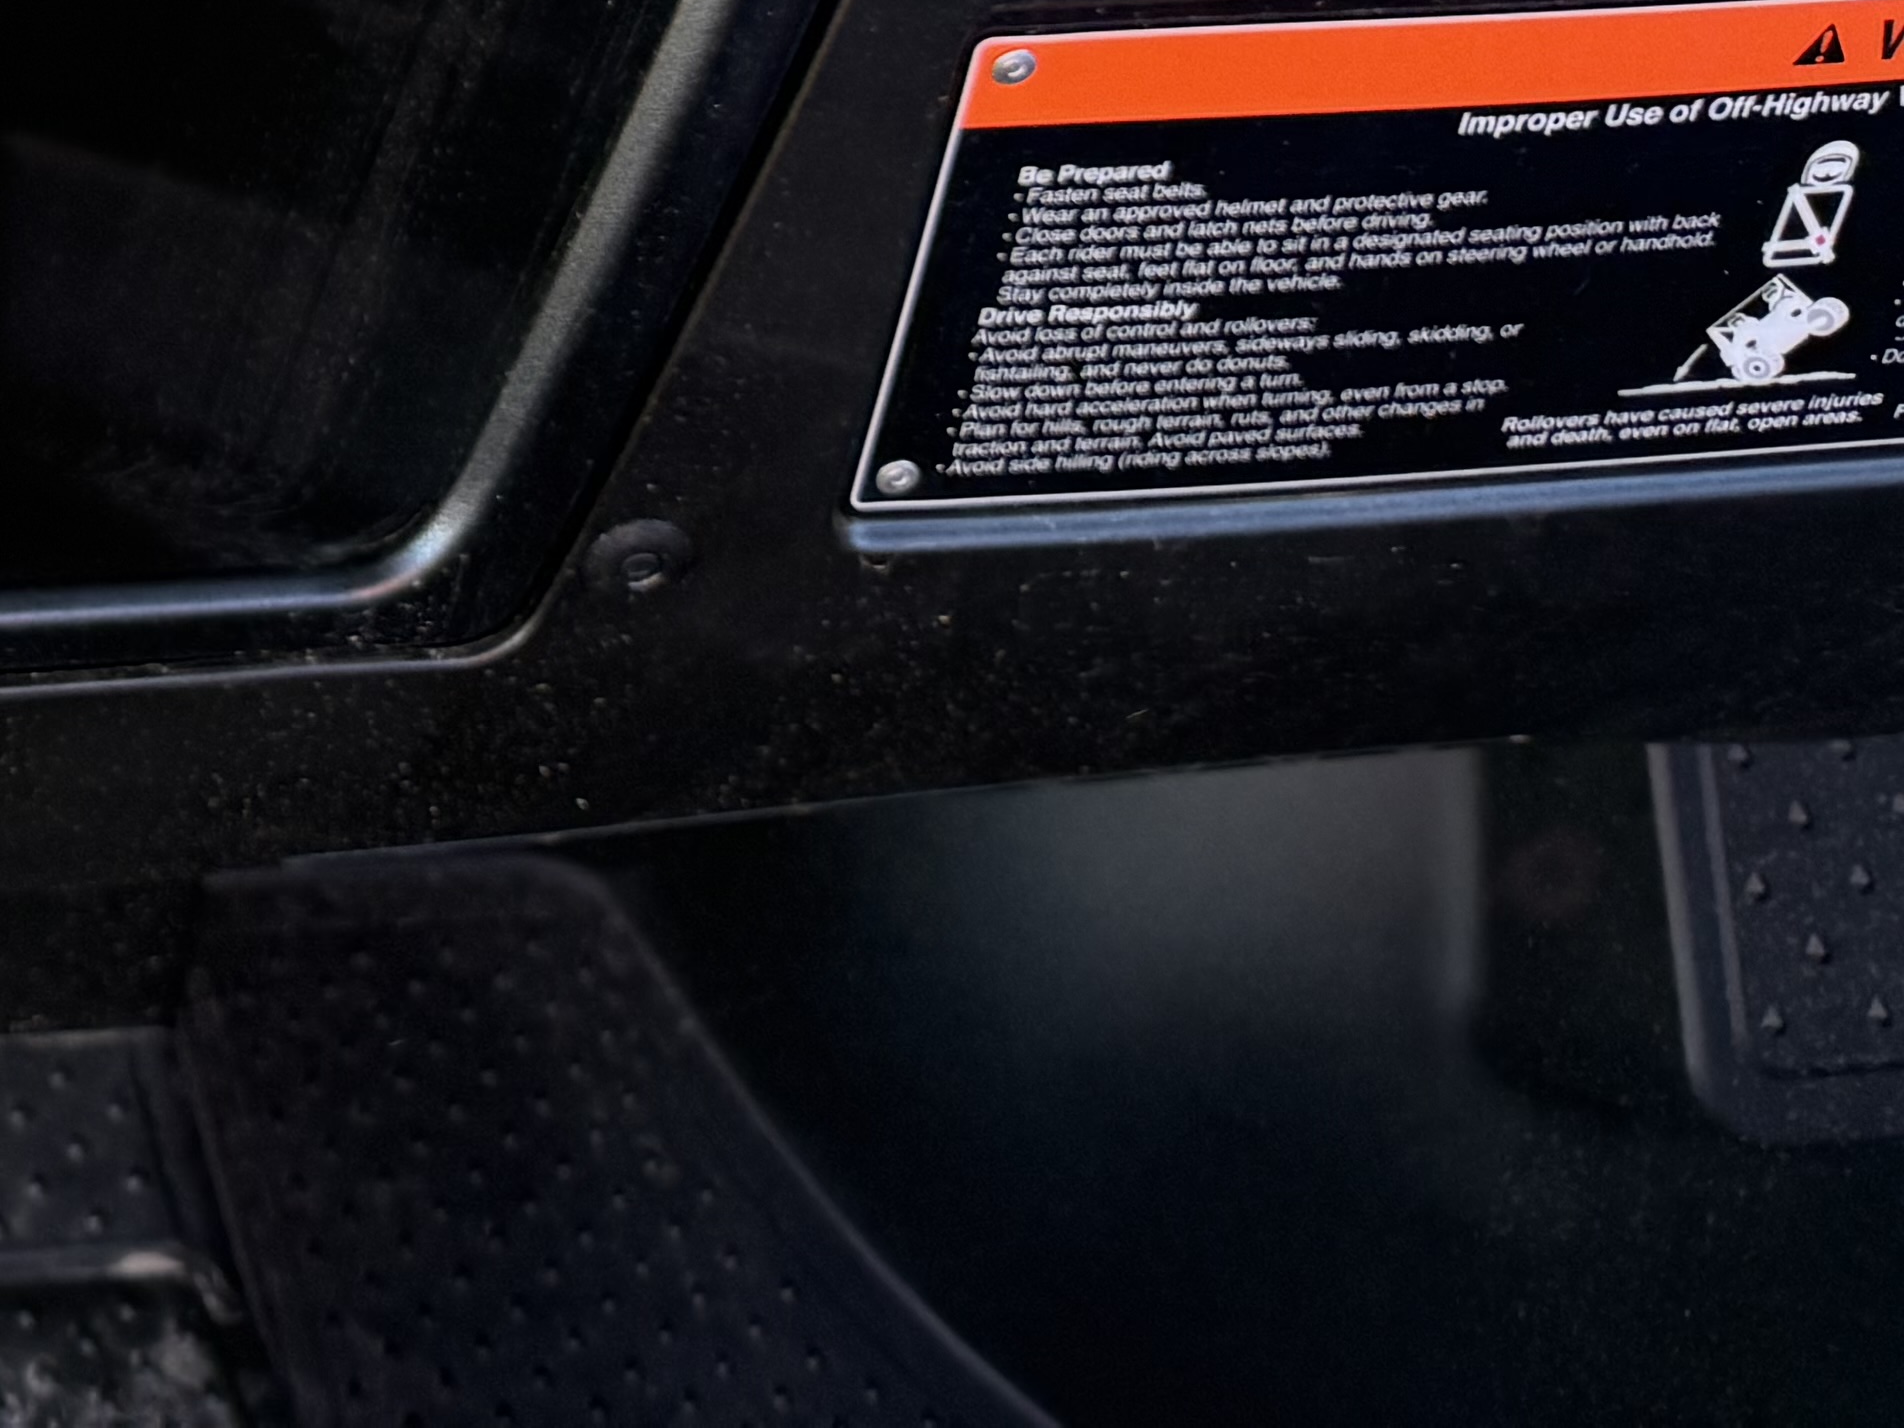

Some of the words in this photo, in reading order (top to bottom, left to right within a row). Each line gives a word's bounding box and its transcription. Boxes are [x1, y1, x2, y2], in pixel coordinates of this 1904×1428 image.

[1458, 110, 1599, 138] Improper
[1605, 103, 1661, 127] Use
[1670, 98, 1700, 122] of
[1708, 89, 1888, 121] Off-Highway
[1018, 166, 1055, 185] Be
[1057, 161, 1172, 185] Prepared
[1021, 207, 1079, 225] Wear
[1081, 208, 1109, 222] an
[1113, 201, 1209, 224] approved
[1215, 198, 1287, 217] helmet
[1290, 196, 1329, 214] and
[1333, 191, 1434, 215] protective
[1438, 188, 1488, 211] gear.
[1025, 185, 1098, 205] Fasten
[1103, 185, 1149, 202] seat
[1015, 227, 1076, 244] Close
[1079, 223, 1140, 242] doors
[1144, 221, 1183, 239] and
[1291, 214, 1357, 231] before
[1361, 211, 1434, 233] driving.
[996, 285, 1045, 306] Stay
[1048, 280, 1160, 304] completely
[1164, 277, 1226, 296] inside
[1229, 275, 1263, 293] the
[977, 307, 1044, 326] Drive
[1048, 300, 1198, 324] Responsibly
[1501, 412, 1600, 432] Rollovers
[1605, 407, 1654, 428] have
[1658, 402, 1732, 423] caused
[1735, 397, 1804, 418] severe
[1808, 391, 1883, 415] injuries
[1507, 428, 1547, 448] and
[1551, 422, 1612, 445] death,
[1618, 420, 1668, 440] even
[1673, 419, 1702, 436] on
[1747, 410, 1797, 432] open
[1801, 407, 1862, 427] areas.
